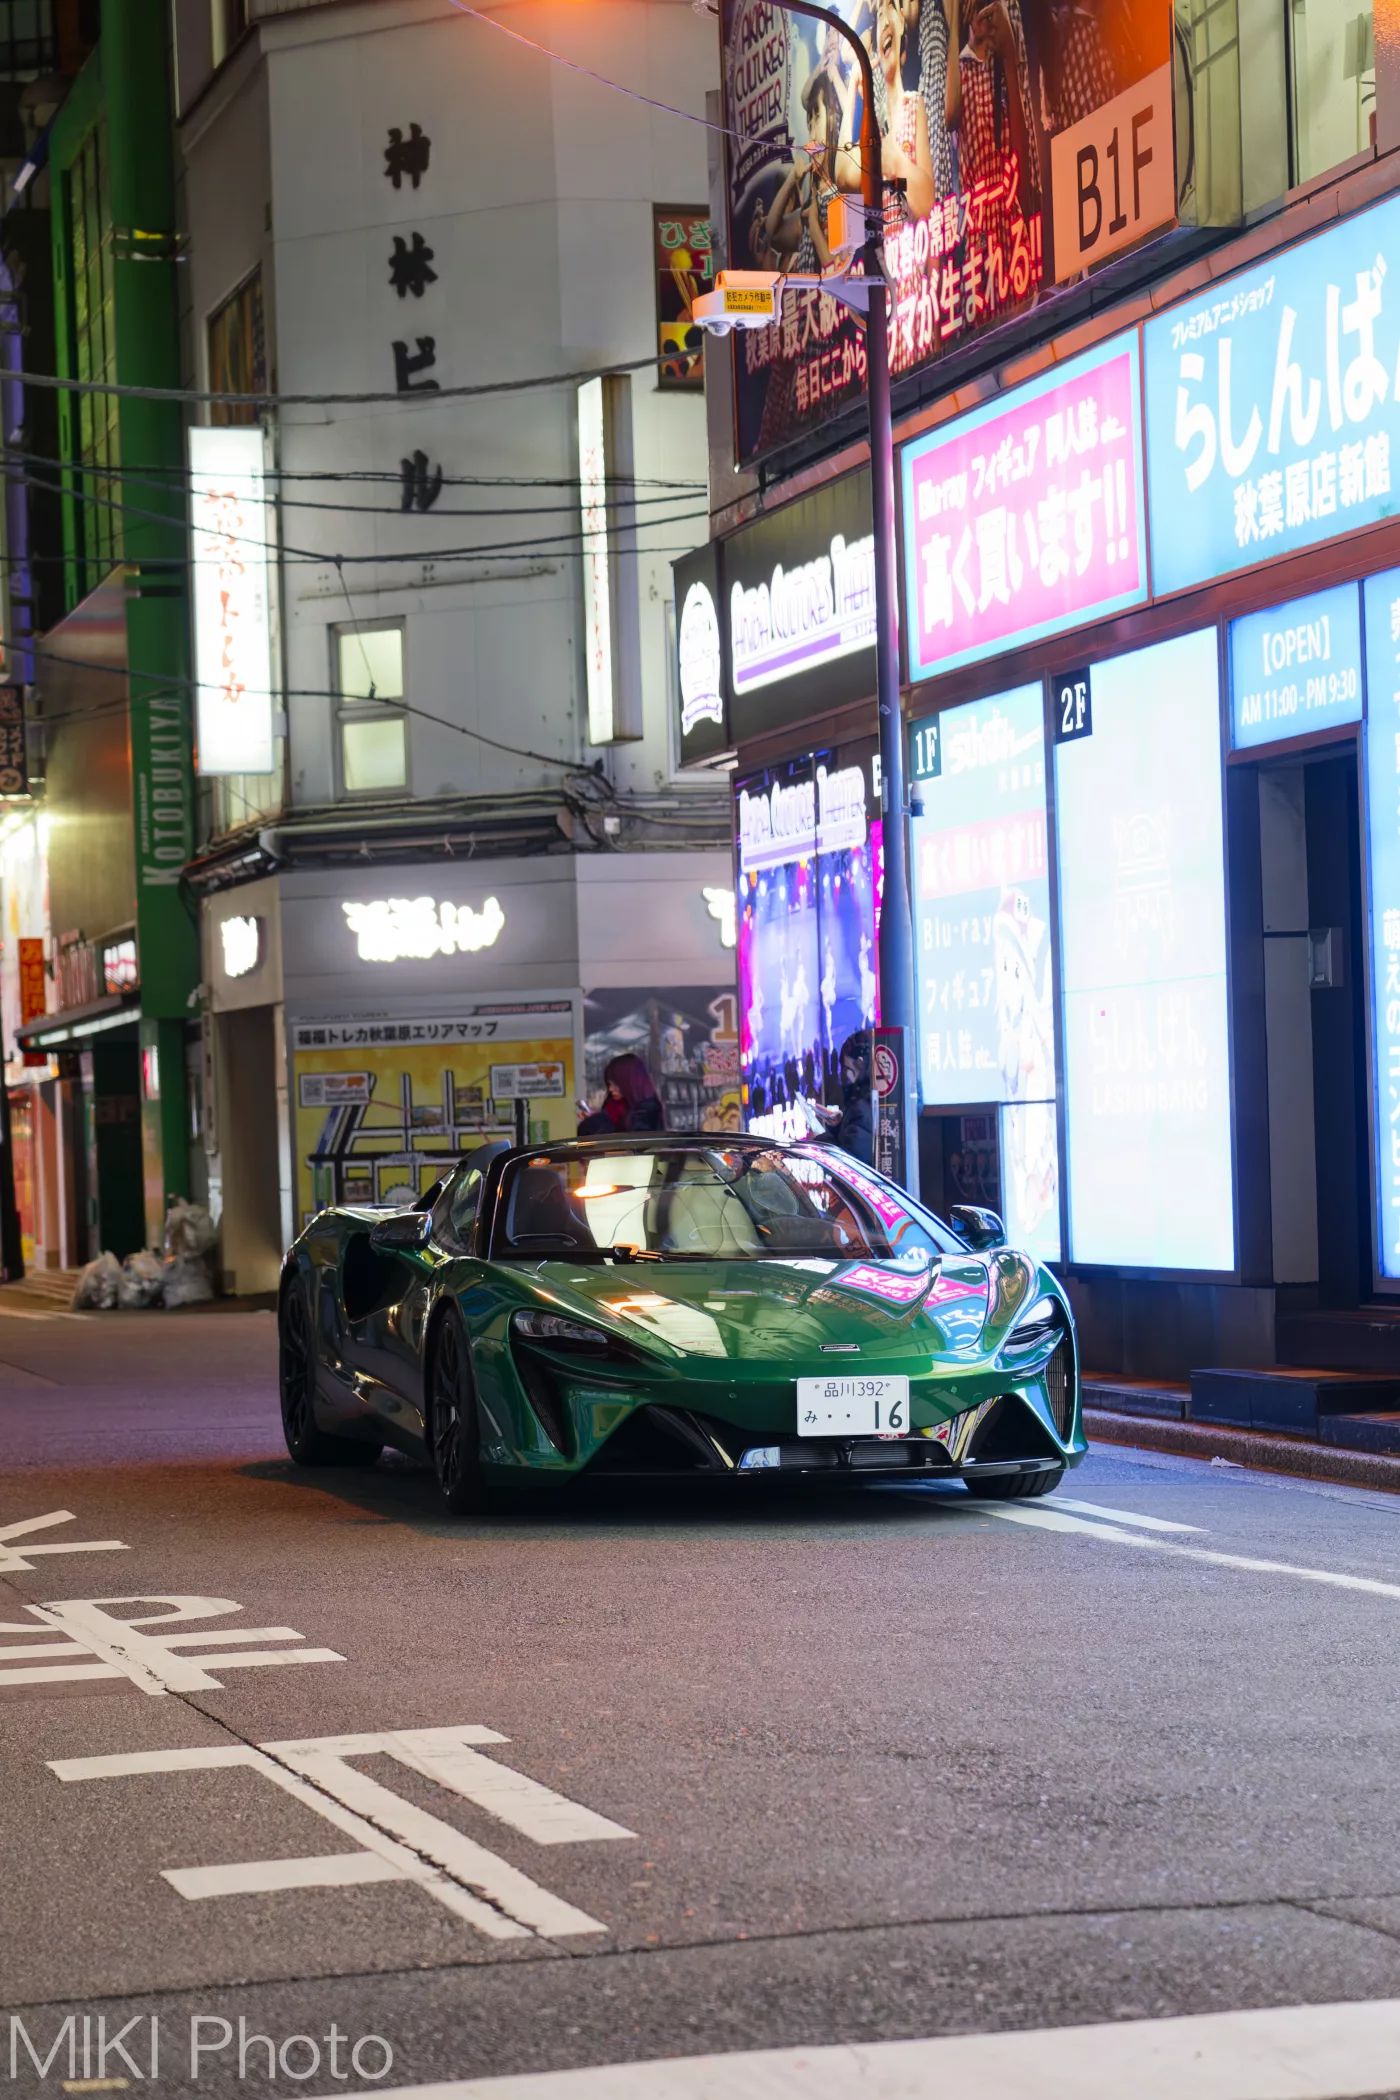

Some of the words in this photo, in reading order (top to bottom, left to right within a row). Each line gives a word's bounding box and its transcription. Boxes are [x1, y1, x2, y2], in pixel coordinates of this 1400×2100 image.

[734, 30, 785, 103] CULTURES
[738, 78, 783, 146] THEATER
[1077, 104, 1153, 253] B1F
[1171, 274, 1276, 350] プレミアムアニメショップ
[1174, 252, 1400, 494] らしんば
[971, 424, 1041, 501] フィギュア
[1233, 430, 1392, 549] 秋葉原店新館
[920, 458, 1130, 635] 高く買います!!
[1060, 685, 1088, 735] 2F
[1240, 693, 1262, 727] AM
[1264, 684, 1298, 720] 11:00
[1306, 675, 1327, 710] PM
[1328, 667, 1357, 704] 9:30
[915, 726, 938, 774] 1F
[142, 698, 188, 886] KOTOBUKIYA
[925, 967, 994, 1015] フィギュア
[804, 1410, 818, 1424] み
[874, 1400, 903, 1430] 16
